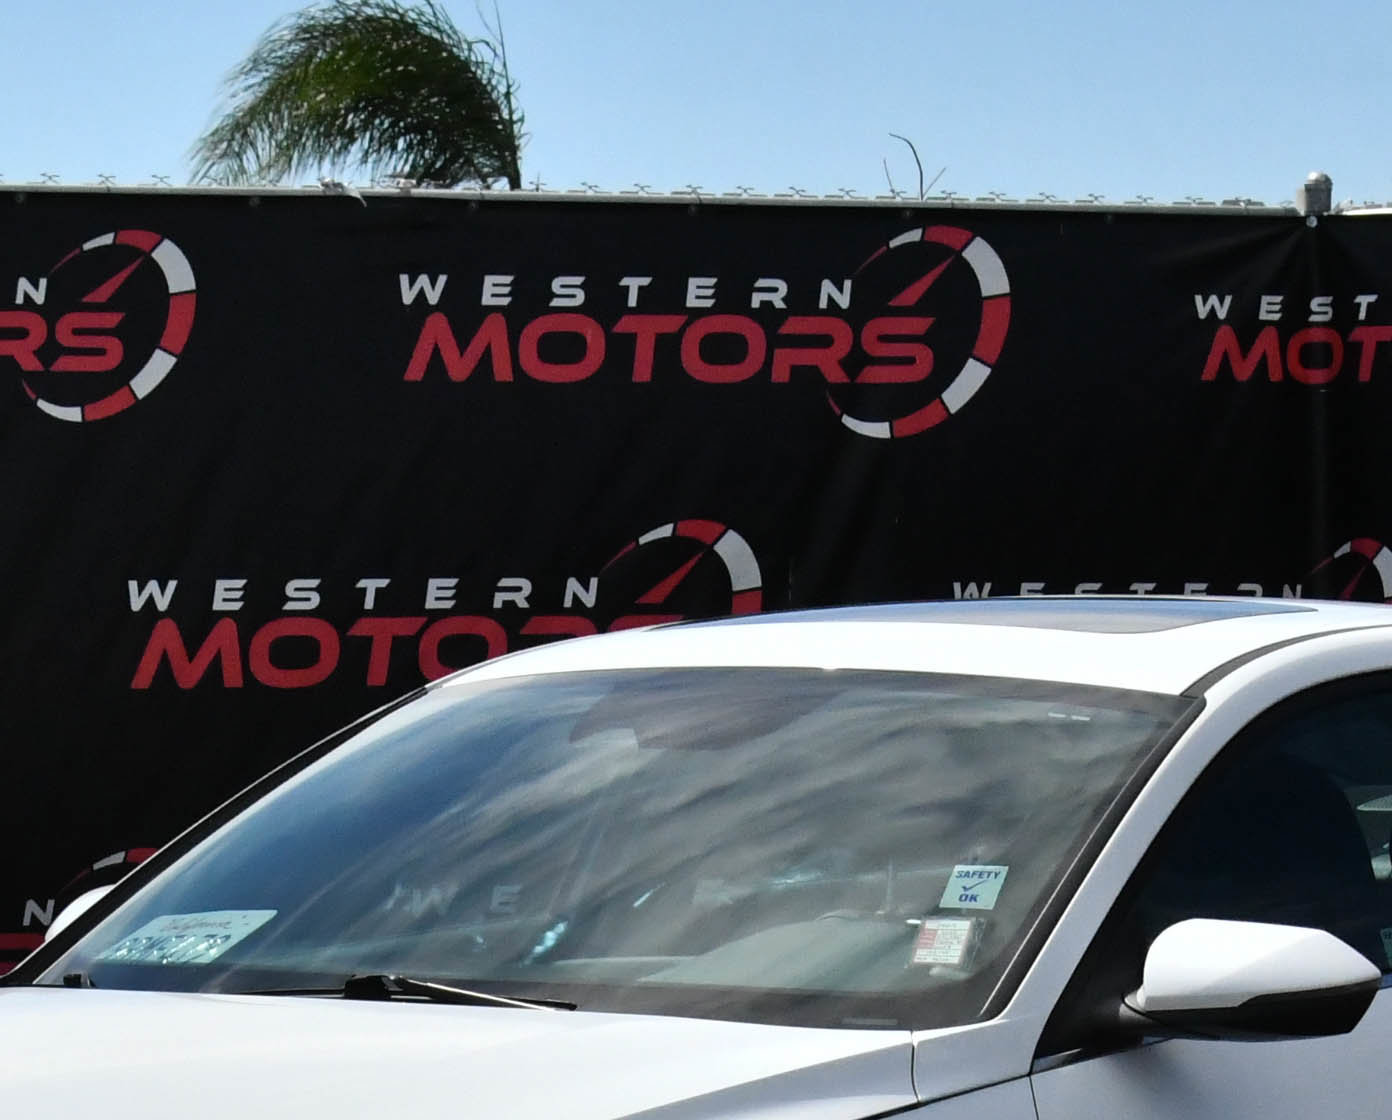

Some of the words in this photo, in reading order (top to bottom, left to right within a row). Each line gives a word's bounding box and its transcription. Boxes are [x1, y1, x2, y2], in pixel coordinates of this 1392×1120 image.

[400, 274, 851, 309] WESTERN
[404, 312, 934, 384] MOTORS
[128, 578, 598, 611] WESTERN
[131, 615, 683, 689] MOTO
[955, 870, 1001, 880] SAFETY
[958, 893, 980, 903] OK
